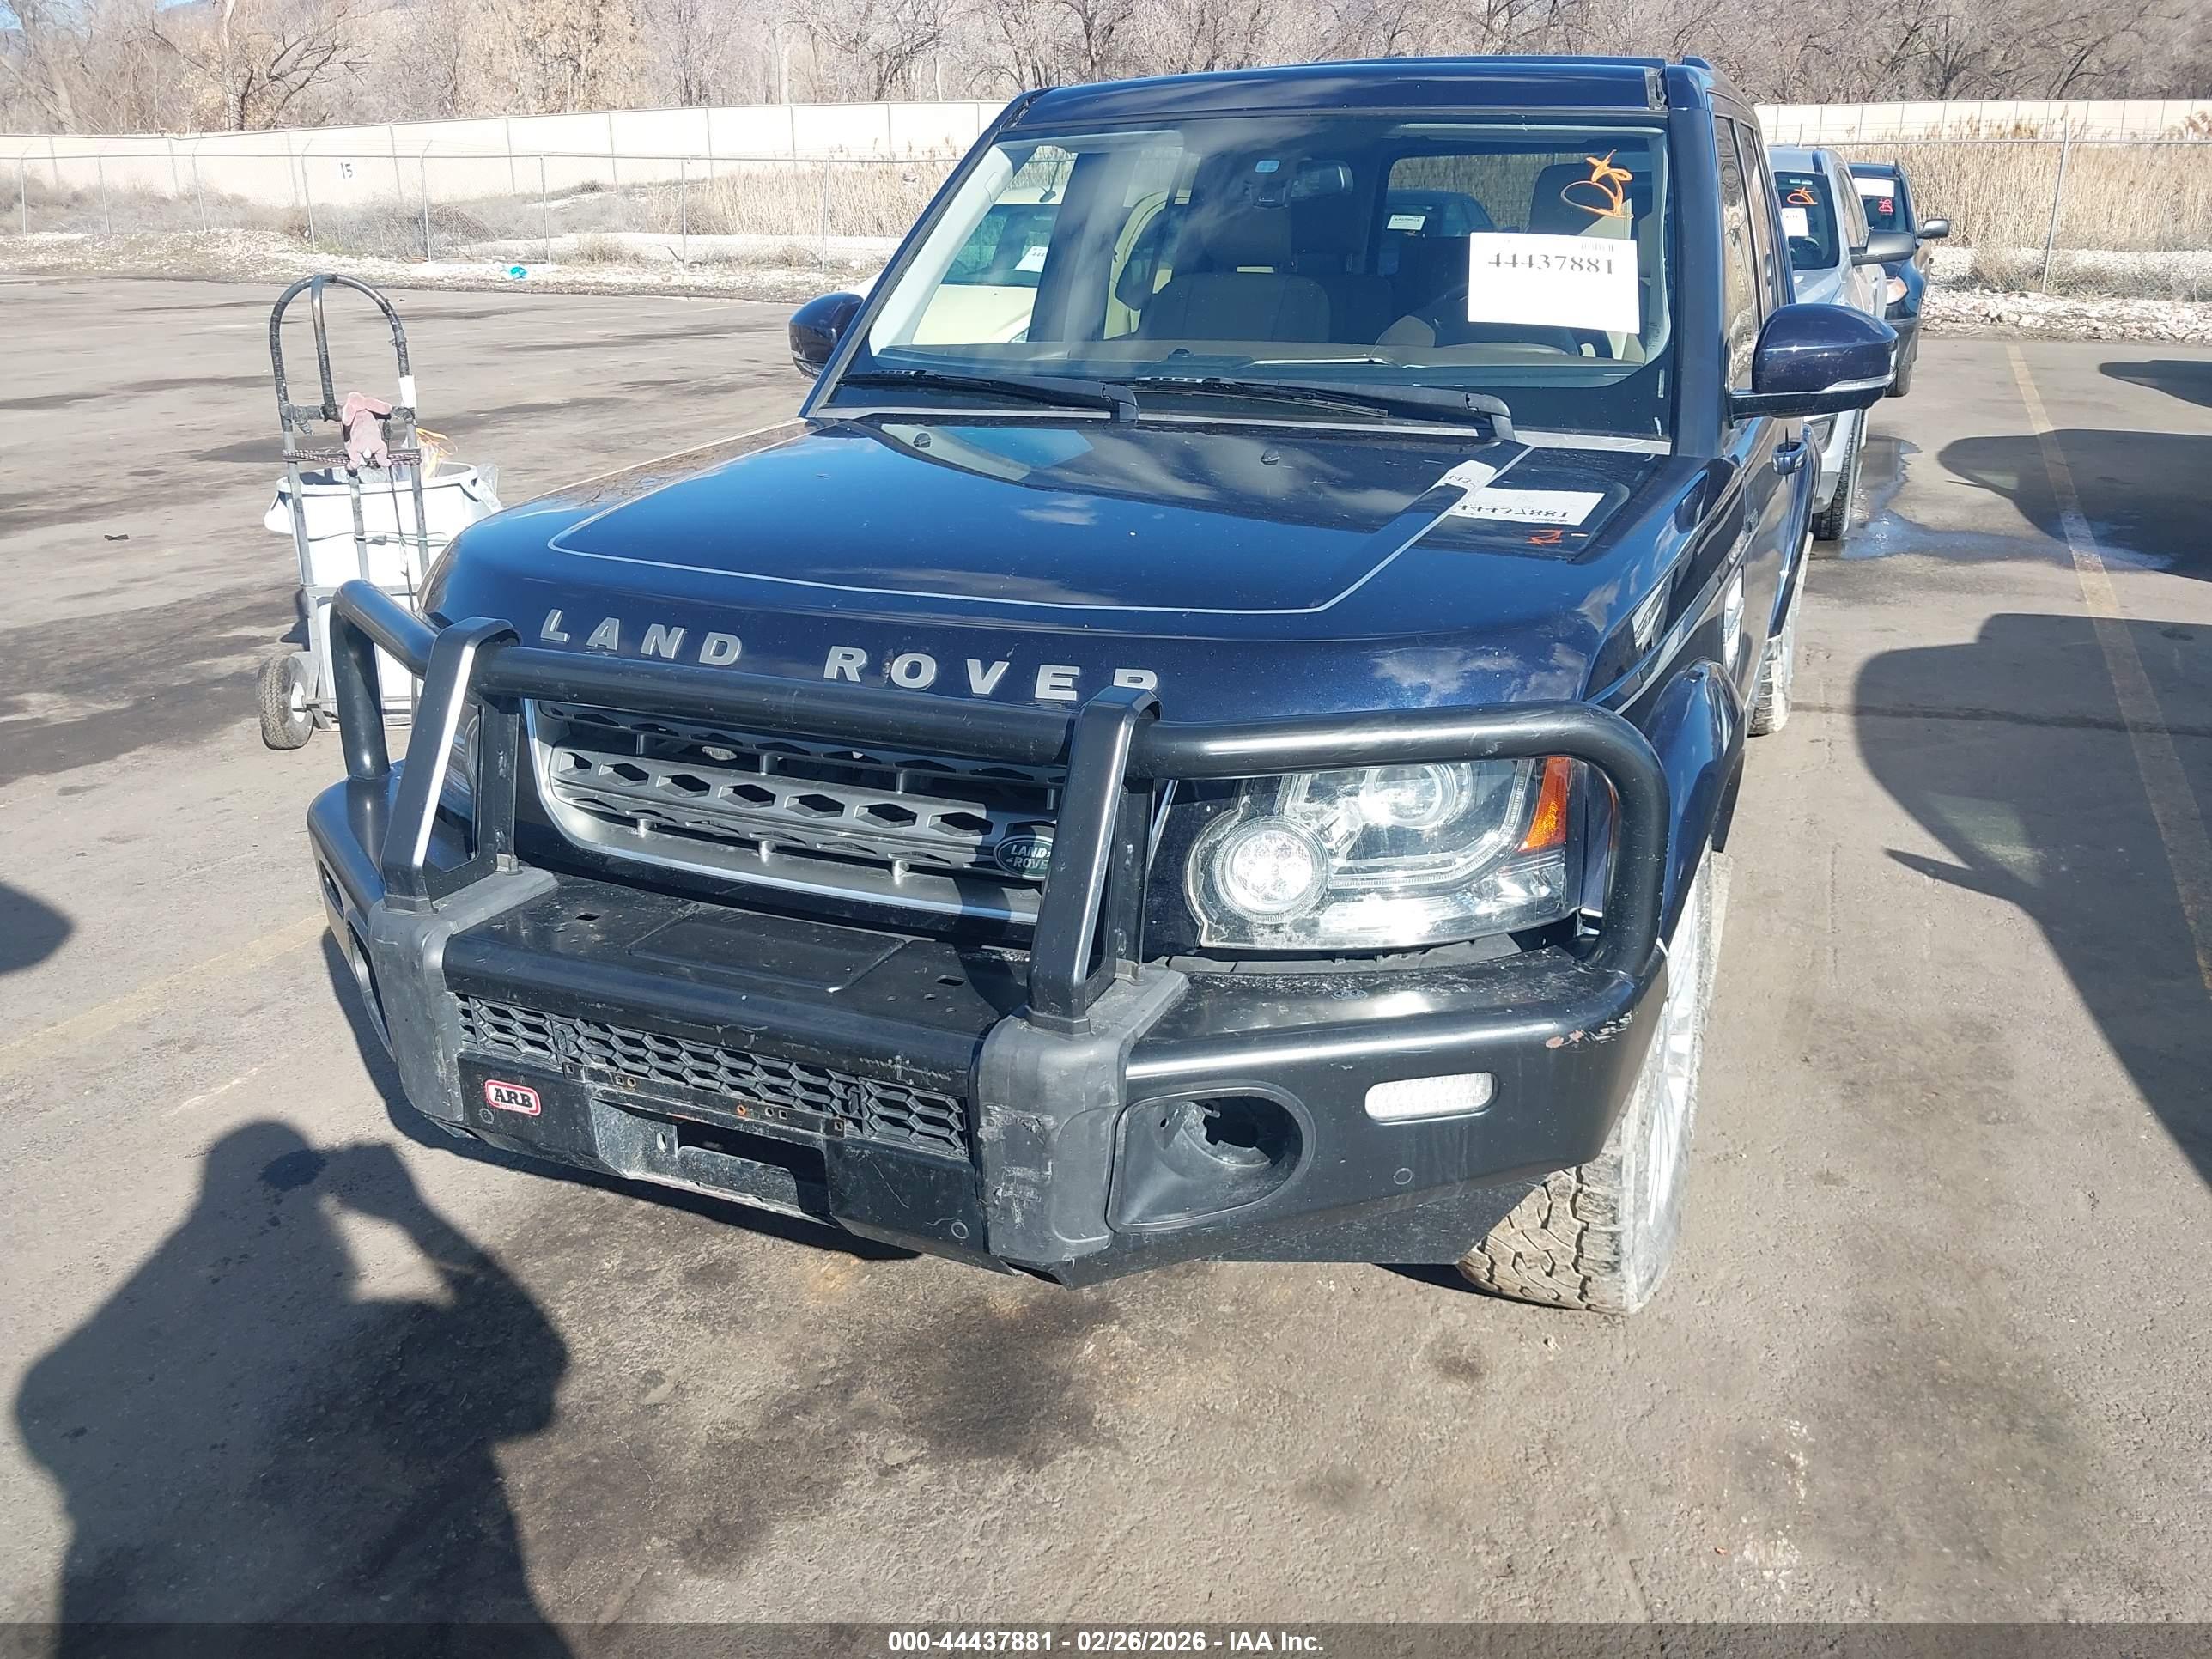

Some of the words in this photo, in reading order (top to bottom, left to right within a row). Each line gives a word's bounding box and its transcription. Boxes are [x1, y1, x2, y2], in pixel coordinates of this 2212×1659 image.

[340, 161, 353, 179] 15
[1487, 252, 1613, 275] 44437881
[540, 608, 742, 667] LAND
[1010, 843, 1048, 859] LAND
[494, 1086, 533, 1109] ARB
